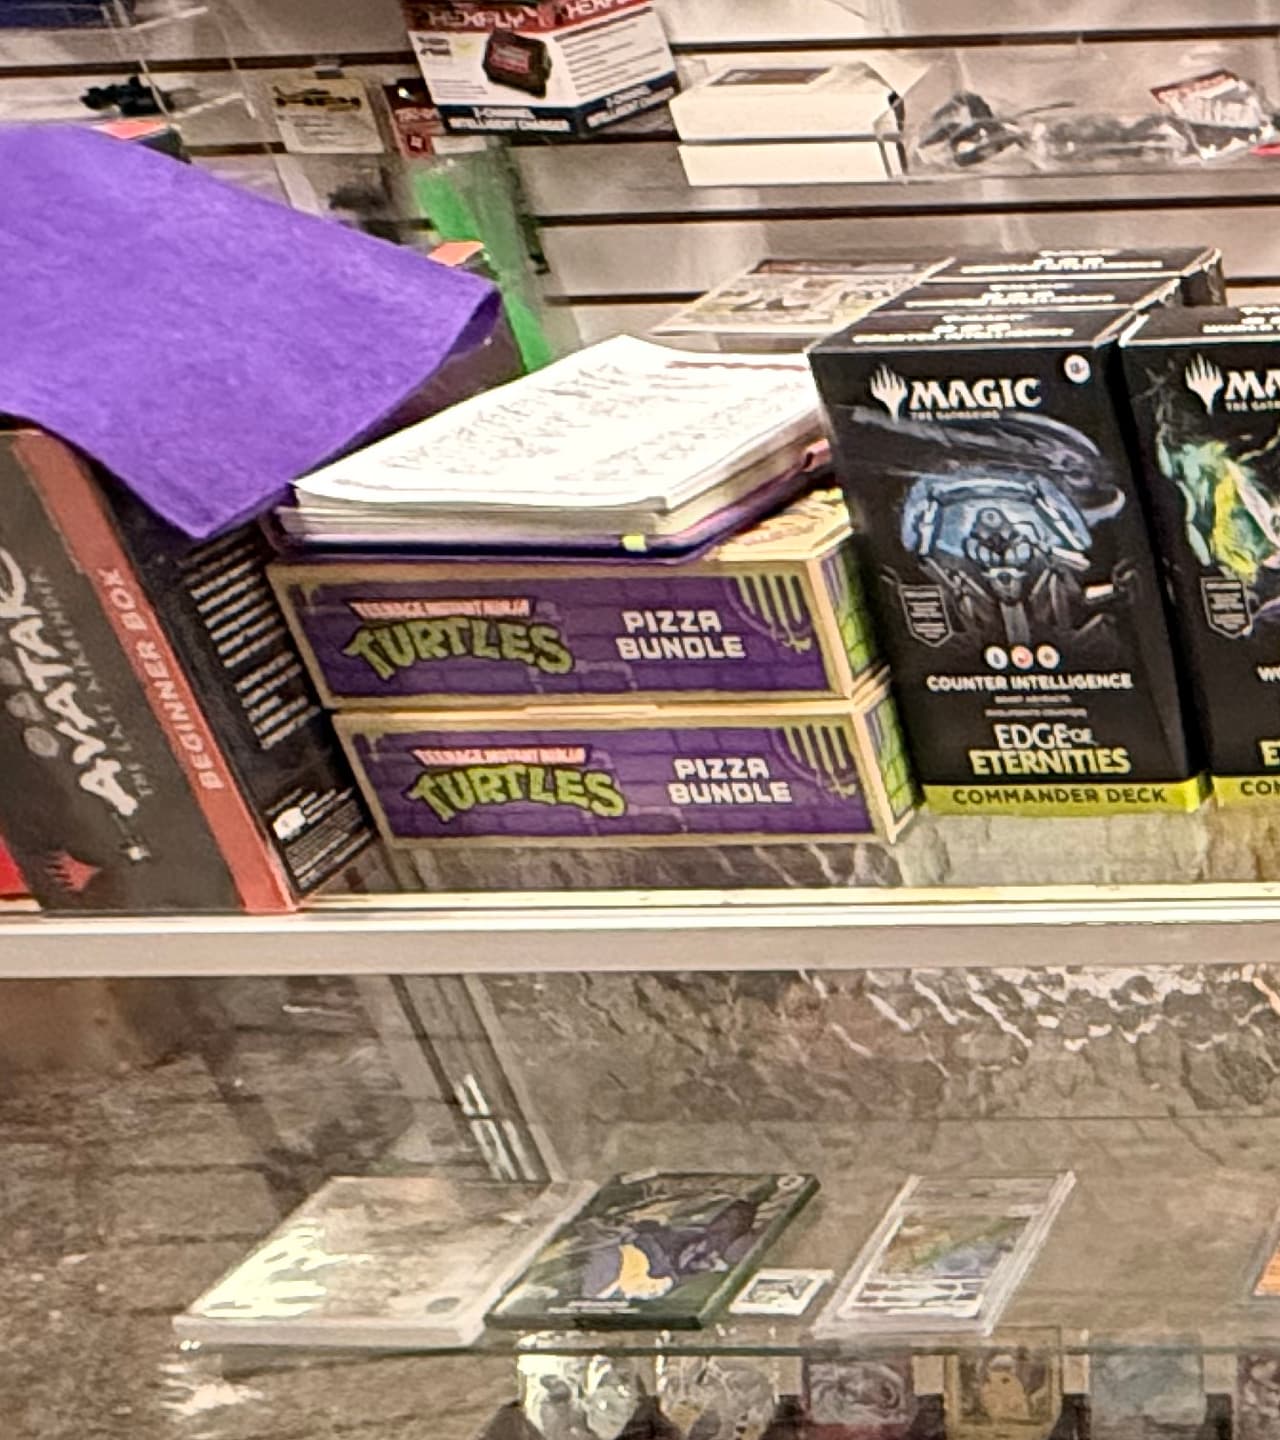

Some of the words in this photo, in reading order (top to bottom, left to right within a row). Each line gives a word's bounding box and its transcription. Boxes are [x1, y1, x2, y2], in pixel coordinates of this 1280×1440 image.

[909, 377, 1042, 412] MAGIC
[96, 566, 148, 632] BOX
[621, 609, 723, 634] PIZZA
[343, 616, 575, 681] TURTLES
[614, 634, 747, 661] BUNDLE
[926, 674, 1008, 692] COUNTER
[1009, 672, 1135, 691] INTELLIGENCE
[135, 639, 225, 791] BEGINNER
[993, 722, 1070, 750] EDGE
[672, 757, 770, 780] PIZZA
[968, 747, 1131, 775] ETERNITIES
[404, 763, 627, 823] TURTLES
[667, 780, 792, 805] BUNDLE
[952, 786, 1098, 805] COMMANDER
[1106, 787, 1168, 804] DECK
